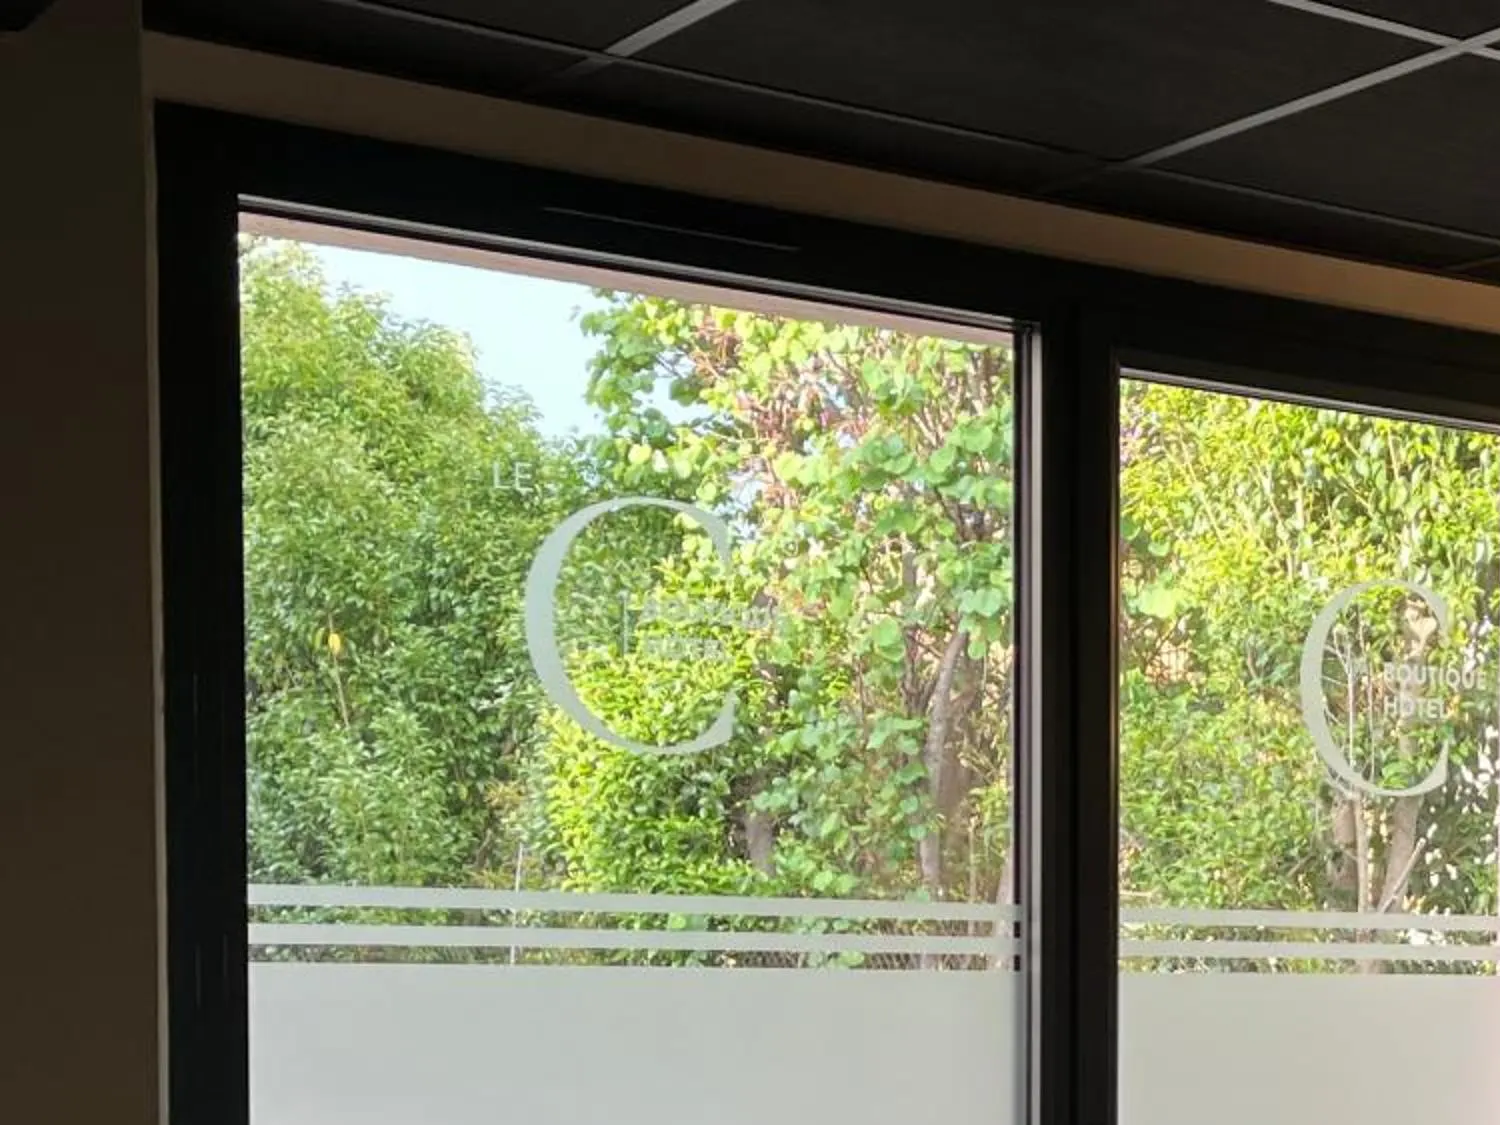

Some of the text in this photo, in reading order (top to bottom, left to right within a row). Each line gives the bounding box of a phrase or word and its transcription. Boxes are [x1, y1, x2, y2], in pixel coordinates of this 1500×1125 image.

[493, 461, 534, 492] LE
[525, 496, 737, 756] C
[1301, 580, 1449, 797] C
[1384, 662, 1487, 692] BOUTIQUE
[1384, 695, 1447, 719] HOTEL
